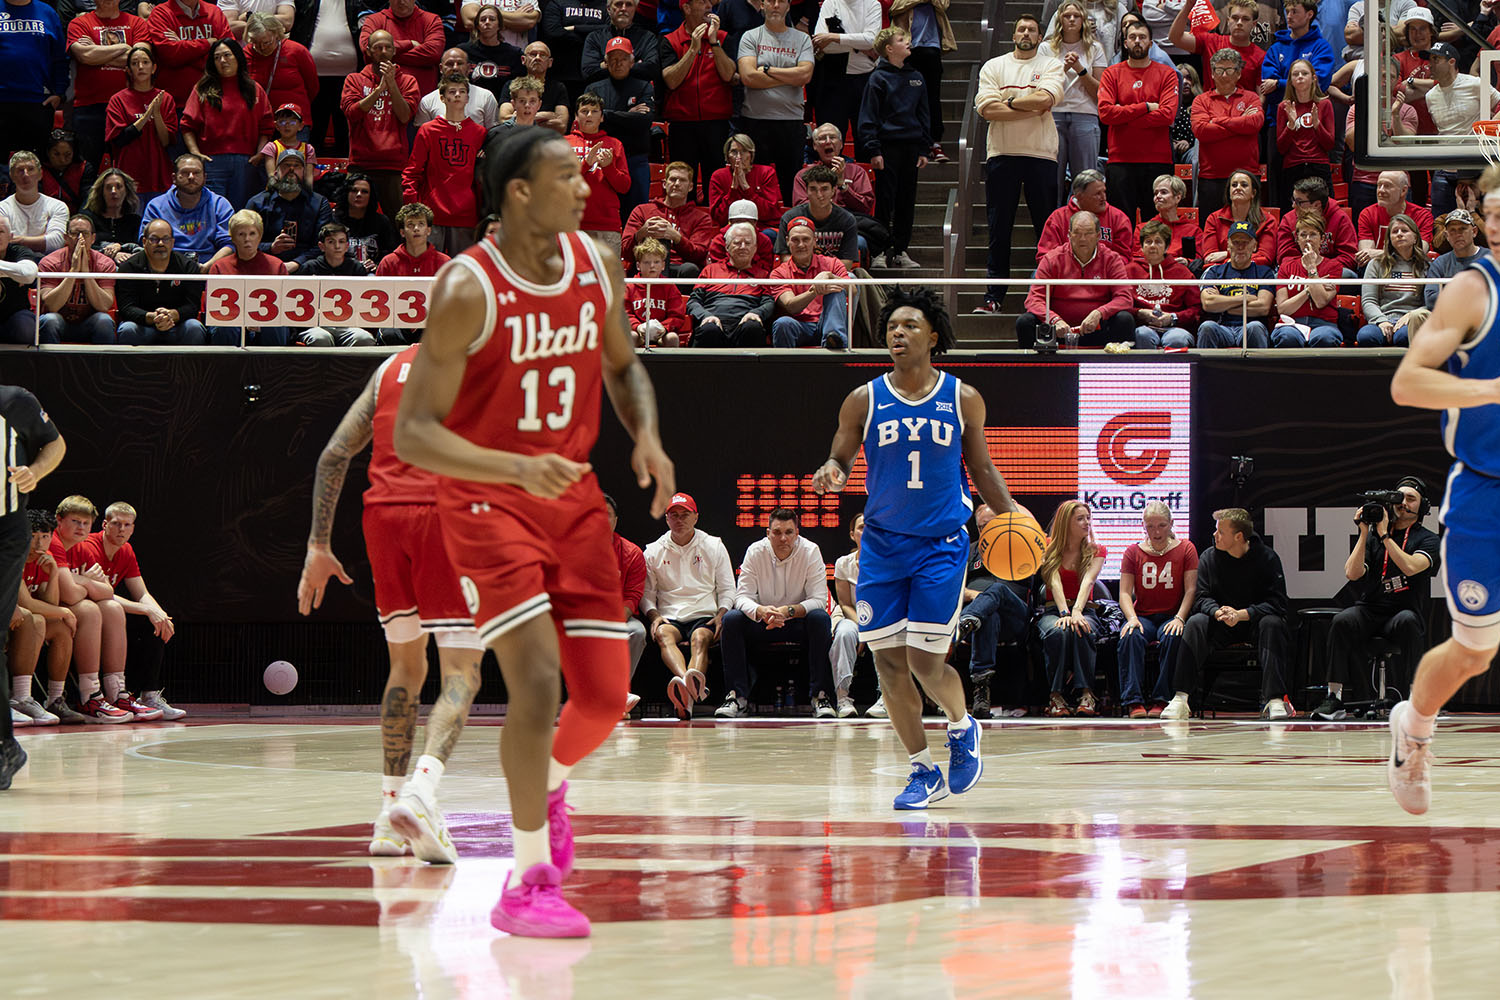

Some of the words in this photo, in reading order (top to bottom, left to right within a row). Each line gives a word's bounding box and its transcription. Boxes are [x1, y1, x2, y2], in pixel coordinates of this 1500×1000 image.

[566, 7, 585, 18] UTAH
[587, 8, 604, 20] UTES
[180, 24, 214, 41] UTAH
[1236, 223, 1248, 231] M
[209, 288, 240, 322] 3
[248, 288, 279, 322] 3
[285, 288, 315, 322] 3
[322, 288, 353, 322] 3
[359, 288, 390, 322] 3
[397, 288, 428, 322] 3
[631, 299, 666, 314] UTAH
[505, 300, 598, 364] Utah
[517, 366, 576, 432] 13
[878, 416, 954, 447] BYU
[906, 450, 924, 489] 1
[1083, 491, 1125, 511] Ken
[1142, 561, 1175, 589] 84
